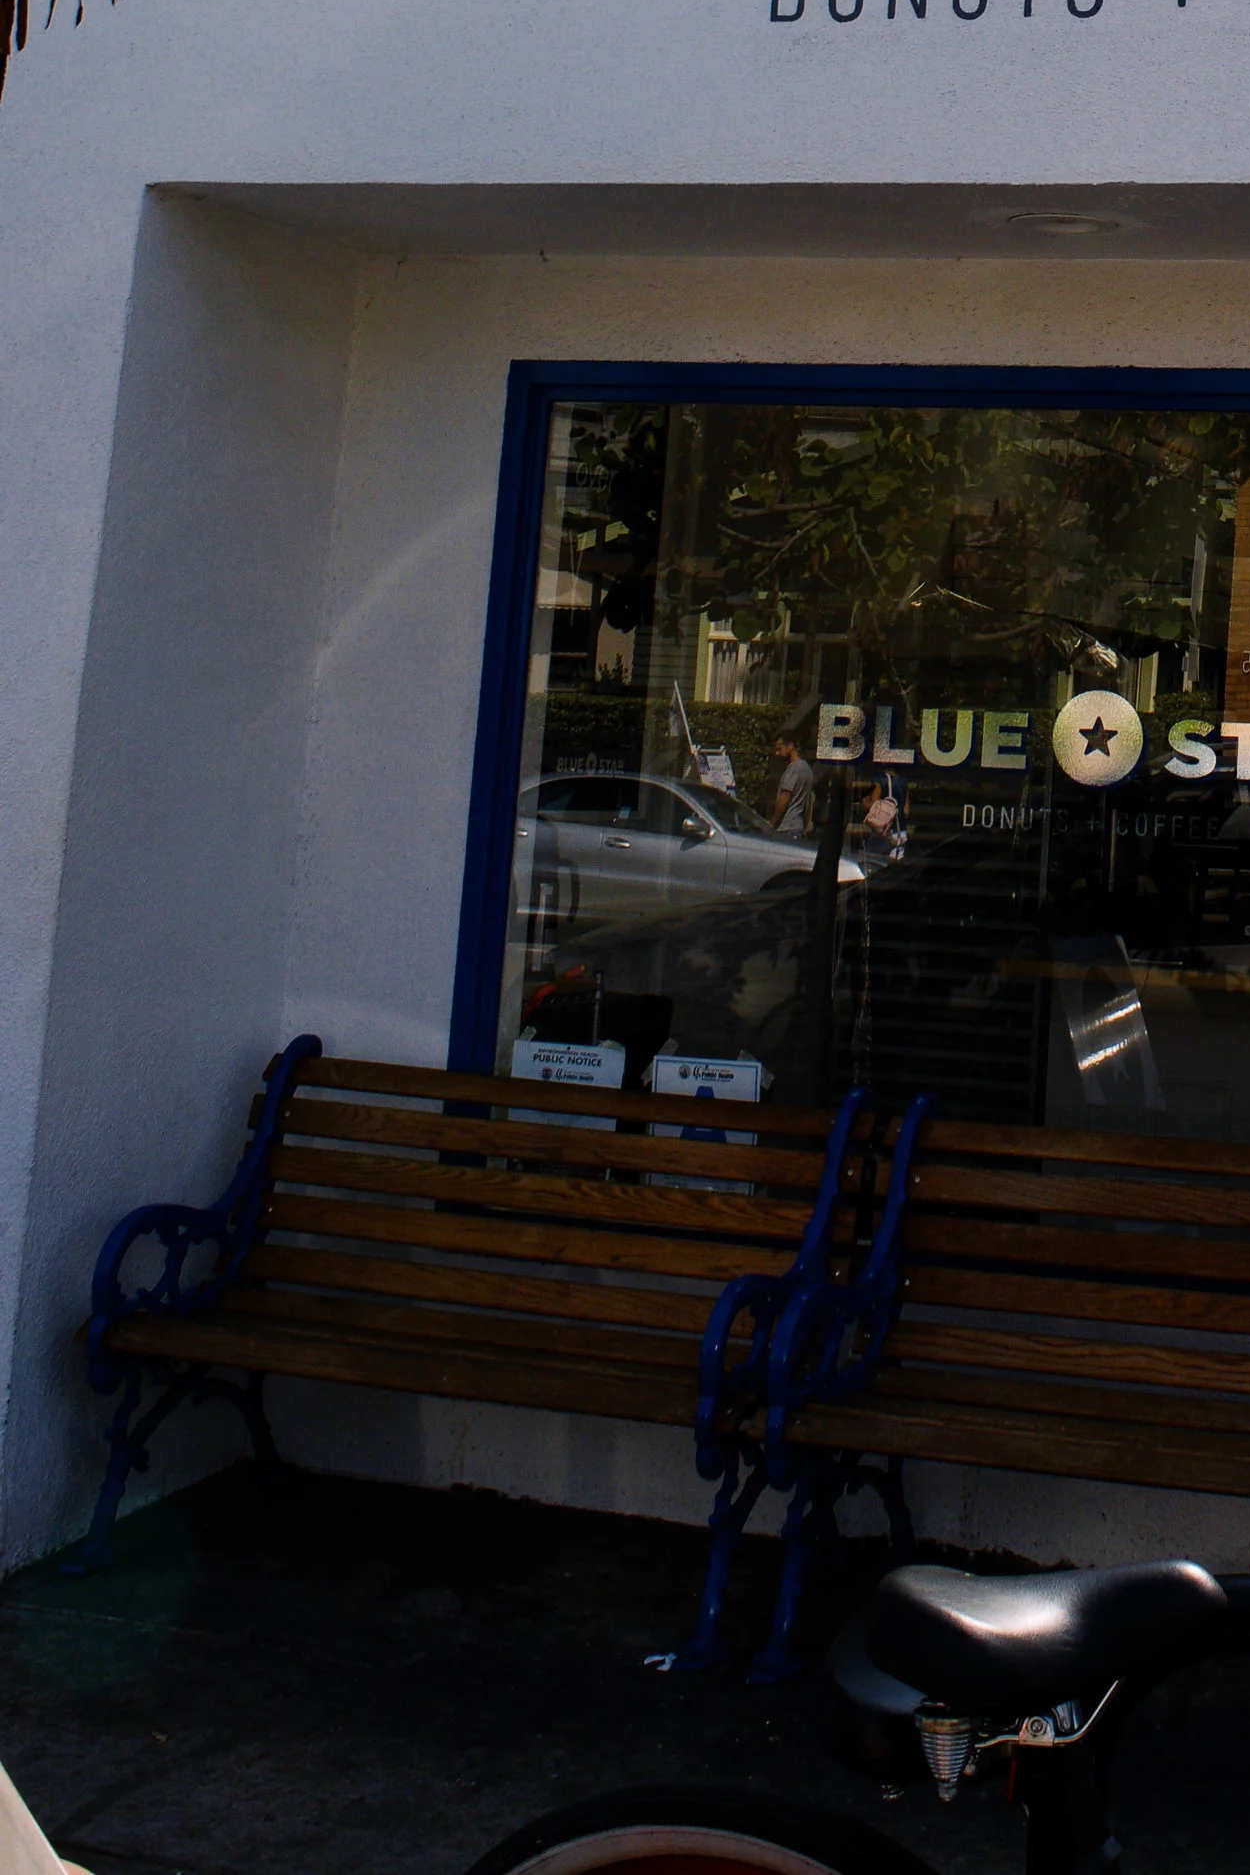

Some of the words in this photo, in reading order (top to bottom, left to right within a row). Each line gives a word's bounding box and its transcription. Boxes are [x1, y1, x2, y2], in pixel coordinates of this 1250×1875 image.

[815, 702, 1030, 771] BLUE
[962, 804, 1070, 833] DONUTS
[1115, 811, 1221, 841] COFFEE
[533, 1053, 565, 1064] PUBLIC
[567, 1056, 602, 1067] NOTICE
